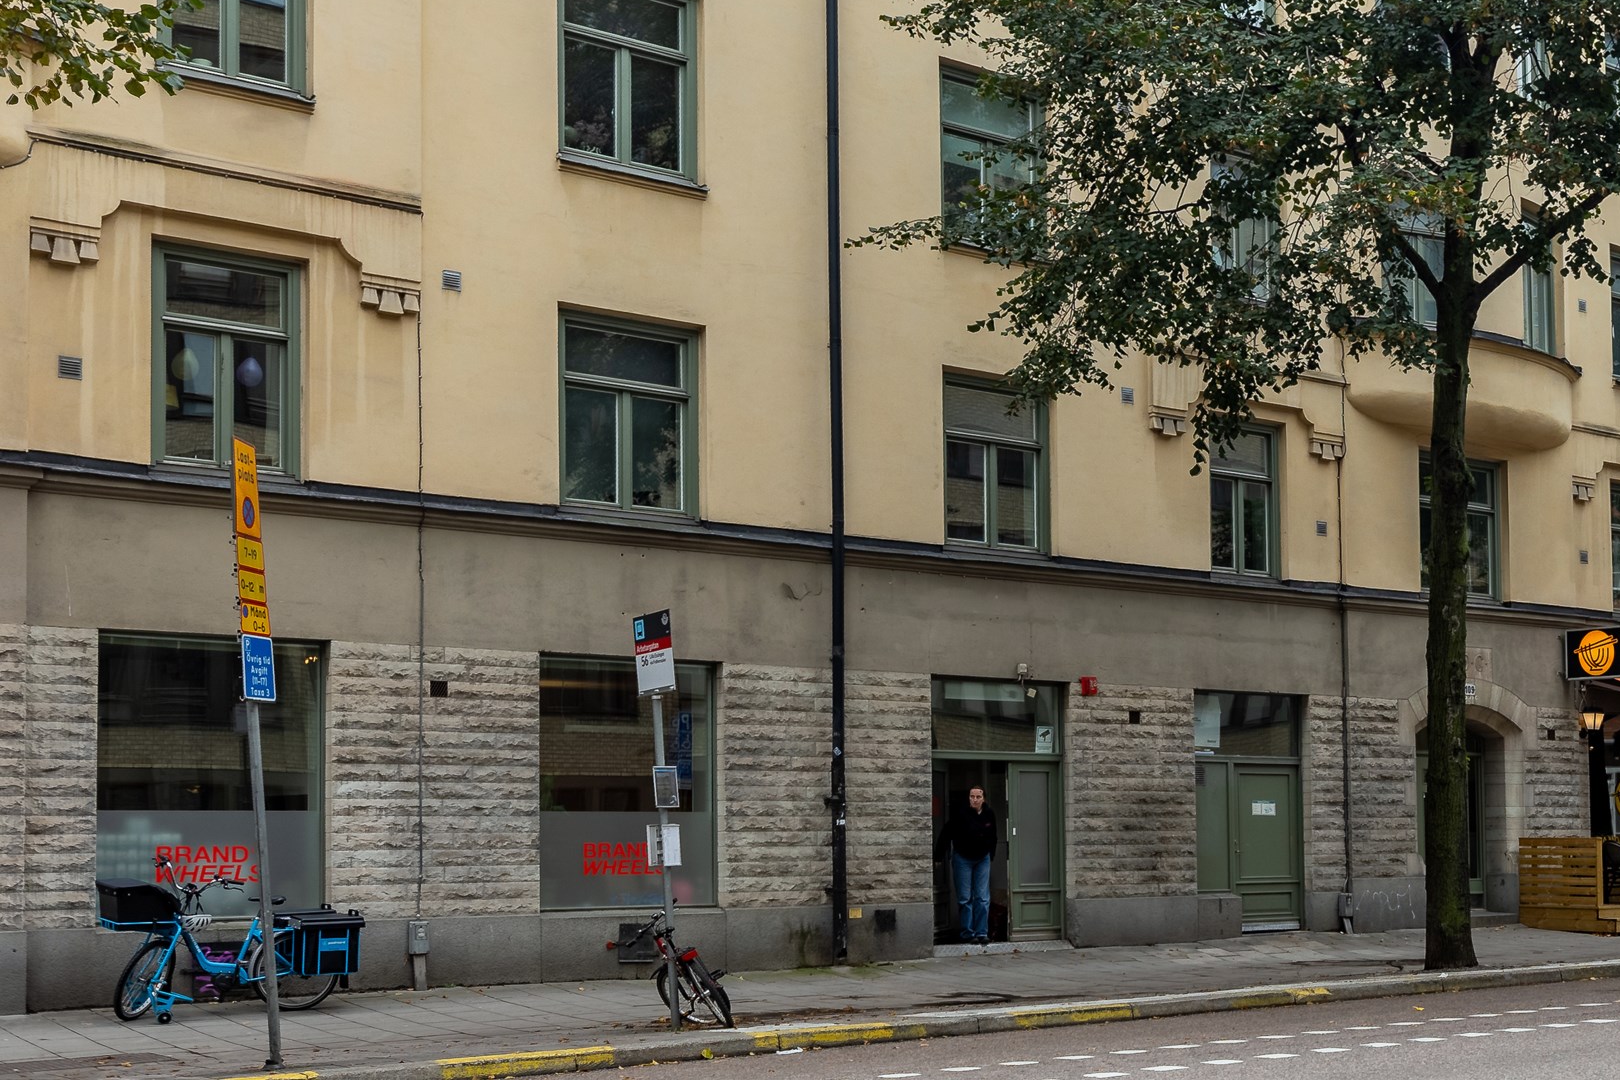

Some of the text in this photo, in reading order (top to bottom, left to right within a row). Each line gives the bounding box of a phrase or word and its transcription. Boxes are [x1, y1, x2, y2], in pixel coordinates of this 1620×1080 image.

[238, 467, 254, 485] plats
[244, 546, 257, 560] 7-19
[241, 579, 255, 593] 0-12
[253, 621, 266, 633] 0-6
[246, 652, 262, 666] Övrig
[641, 655, 649, 667] 56
[251, 687, 265, 697] Taxa
[155, 845, 250, 863] BRAND
